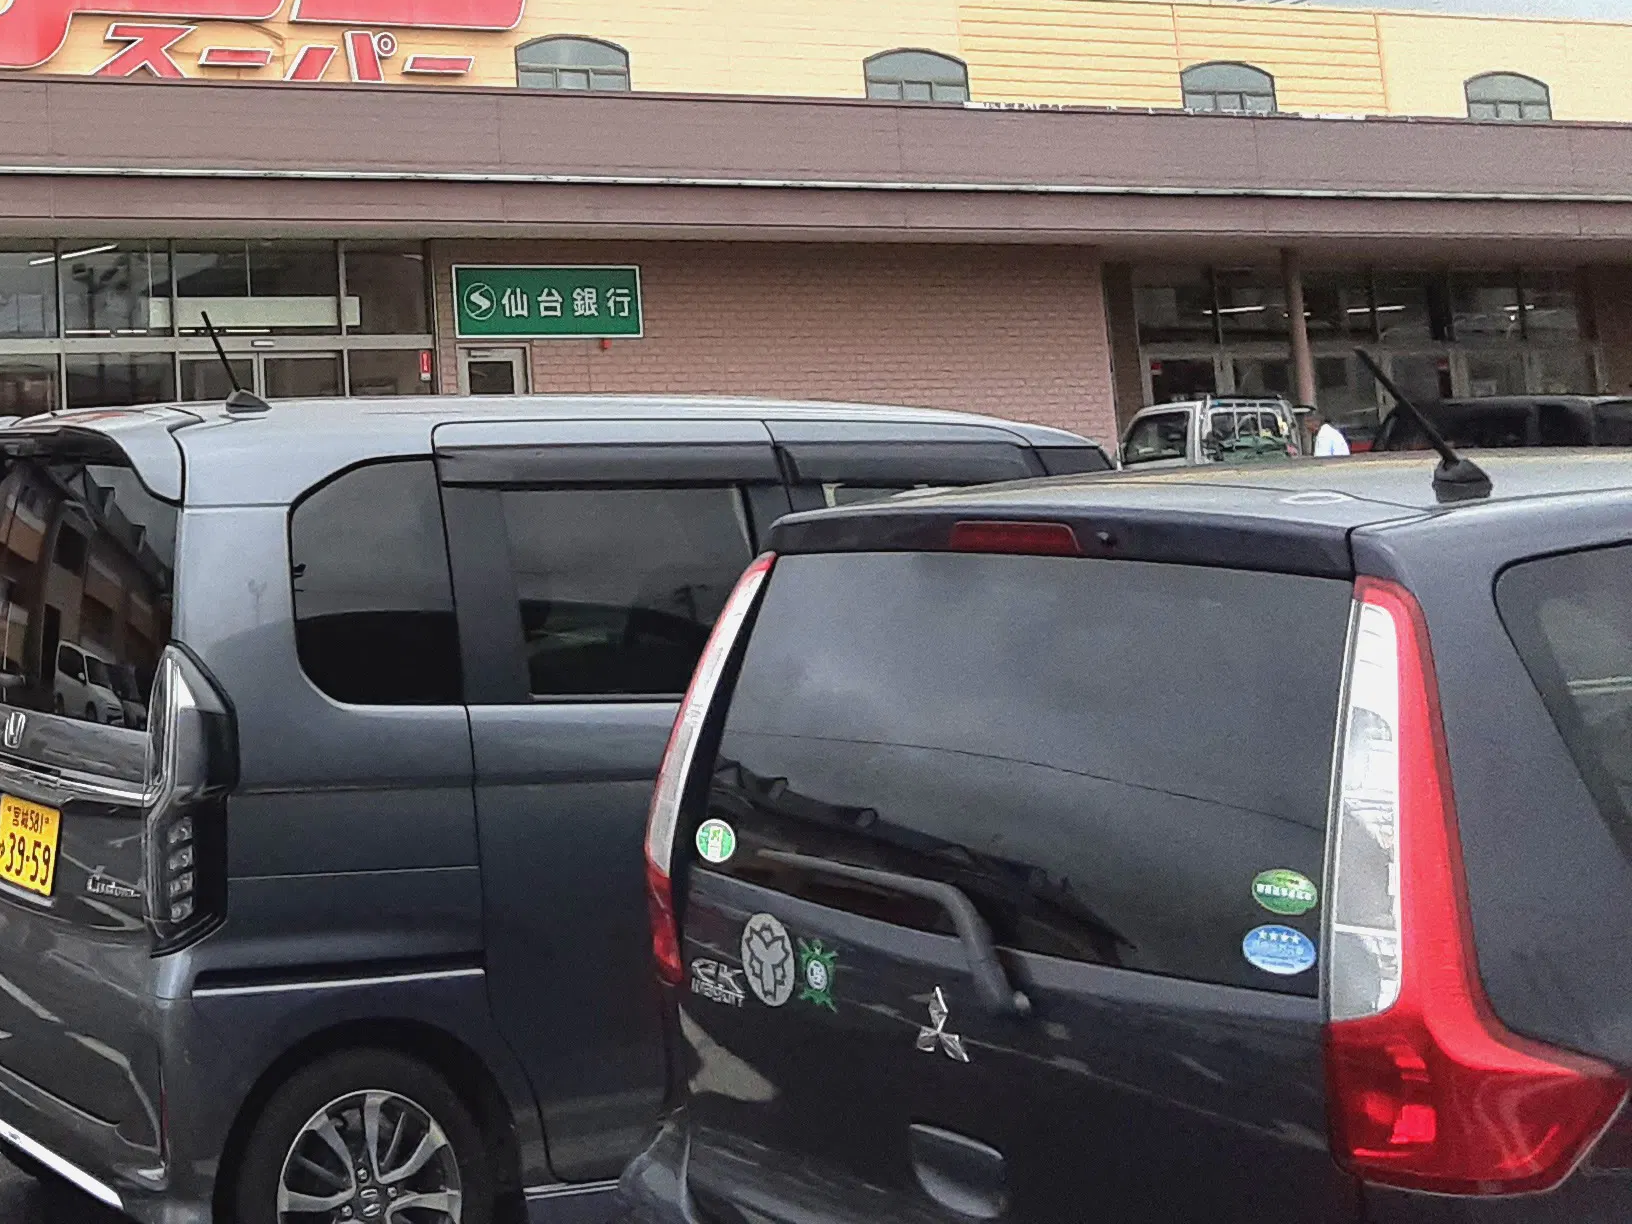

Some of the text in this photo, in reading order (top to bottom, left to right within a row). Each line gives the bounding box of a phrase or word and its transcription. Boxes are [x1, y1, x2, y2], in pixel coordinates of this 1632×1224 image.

[90, 23, 474, 81] スーパー
[501, 287, 632, 318] 仙台銀行
